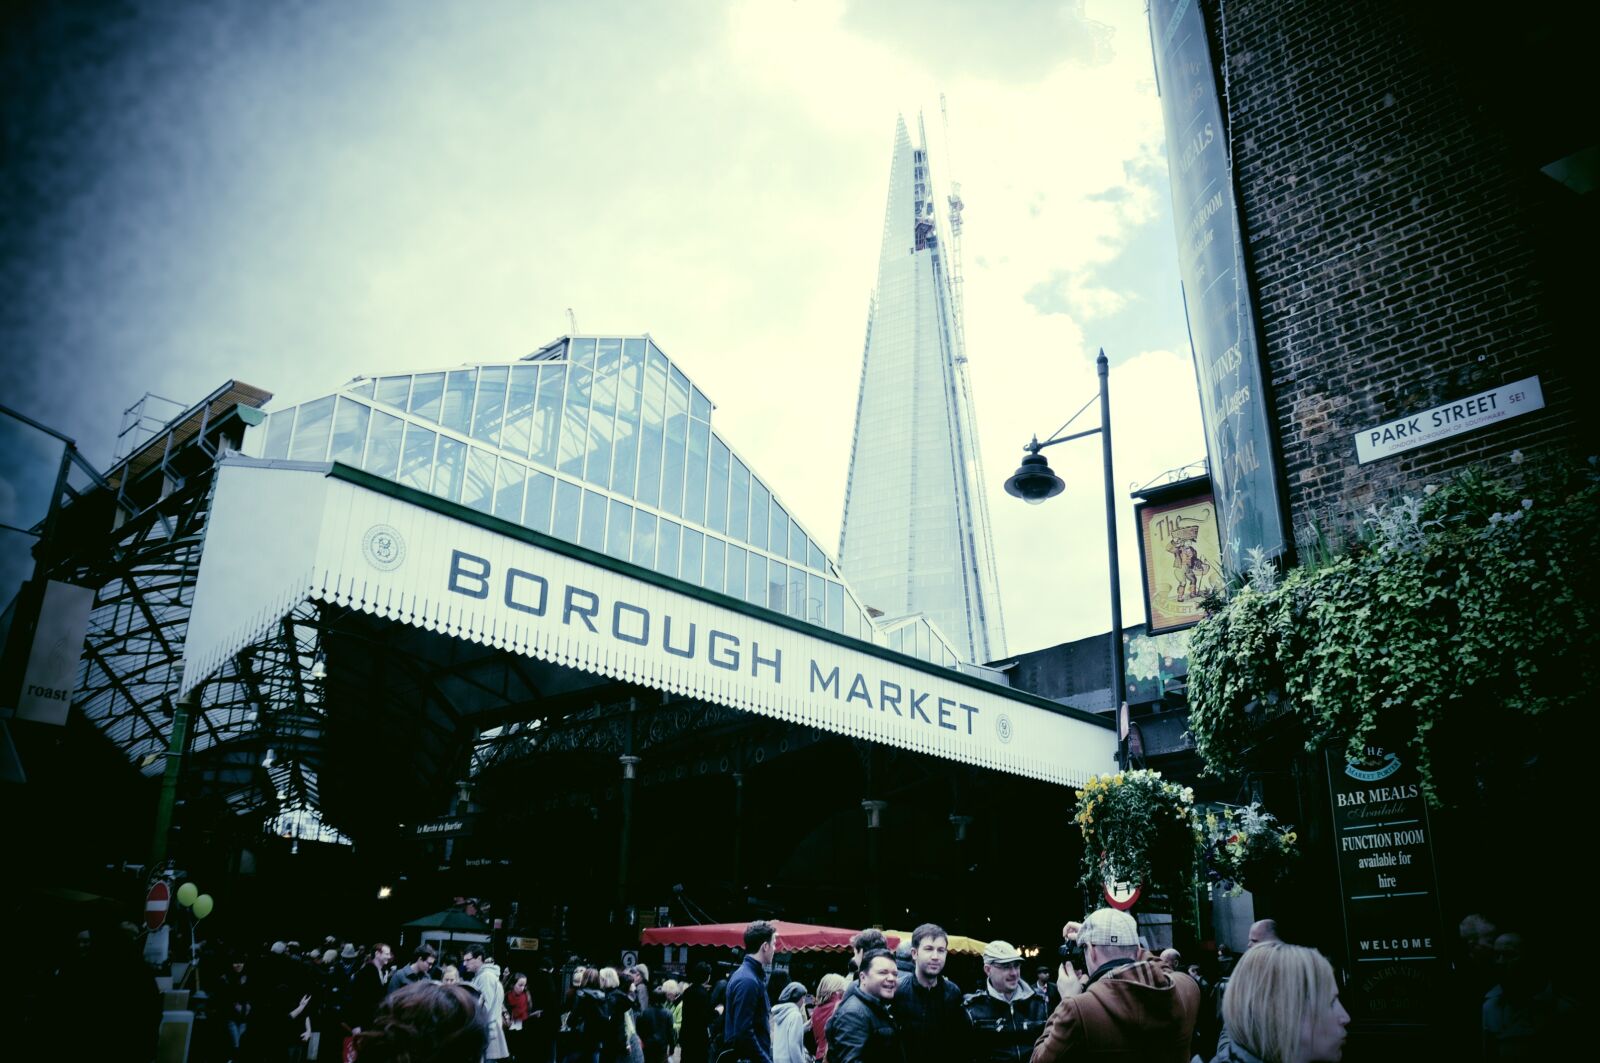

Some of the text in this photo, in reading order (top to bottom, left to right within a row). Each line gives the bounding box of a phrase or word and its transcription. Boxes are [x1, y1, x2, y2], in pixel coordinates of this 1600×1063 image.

[1371, 391, 1526, 447] PARK STREET SE1
[1388, 410, 1506, 451] LONDON BOROUGH OF SOUTHWARK
[448, 548, 979, 735] BOROUGH MARKET
[27, 684, 67, 701] roast
[1336, 784, 1419, 807] BAR MEALS
[1346, 800, 1406, 819] Available
[1341, 829, 1425, 851] FUNCTION ROOM
[1358, 851, 1412, 869] available for
[1378, 873, 1397, 888] hire
[1360, 938, 1433, 950] WELCOME
